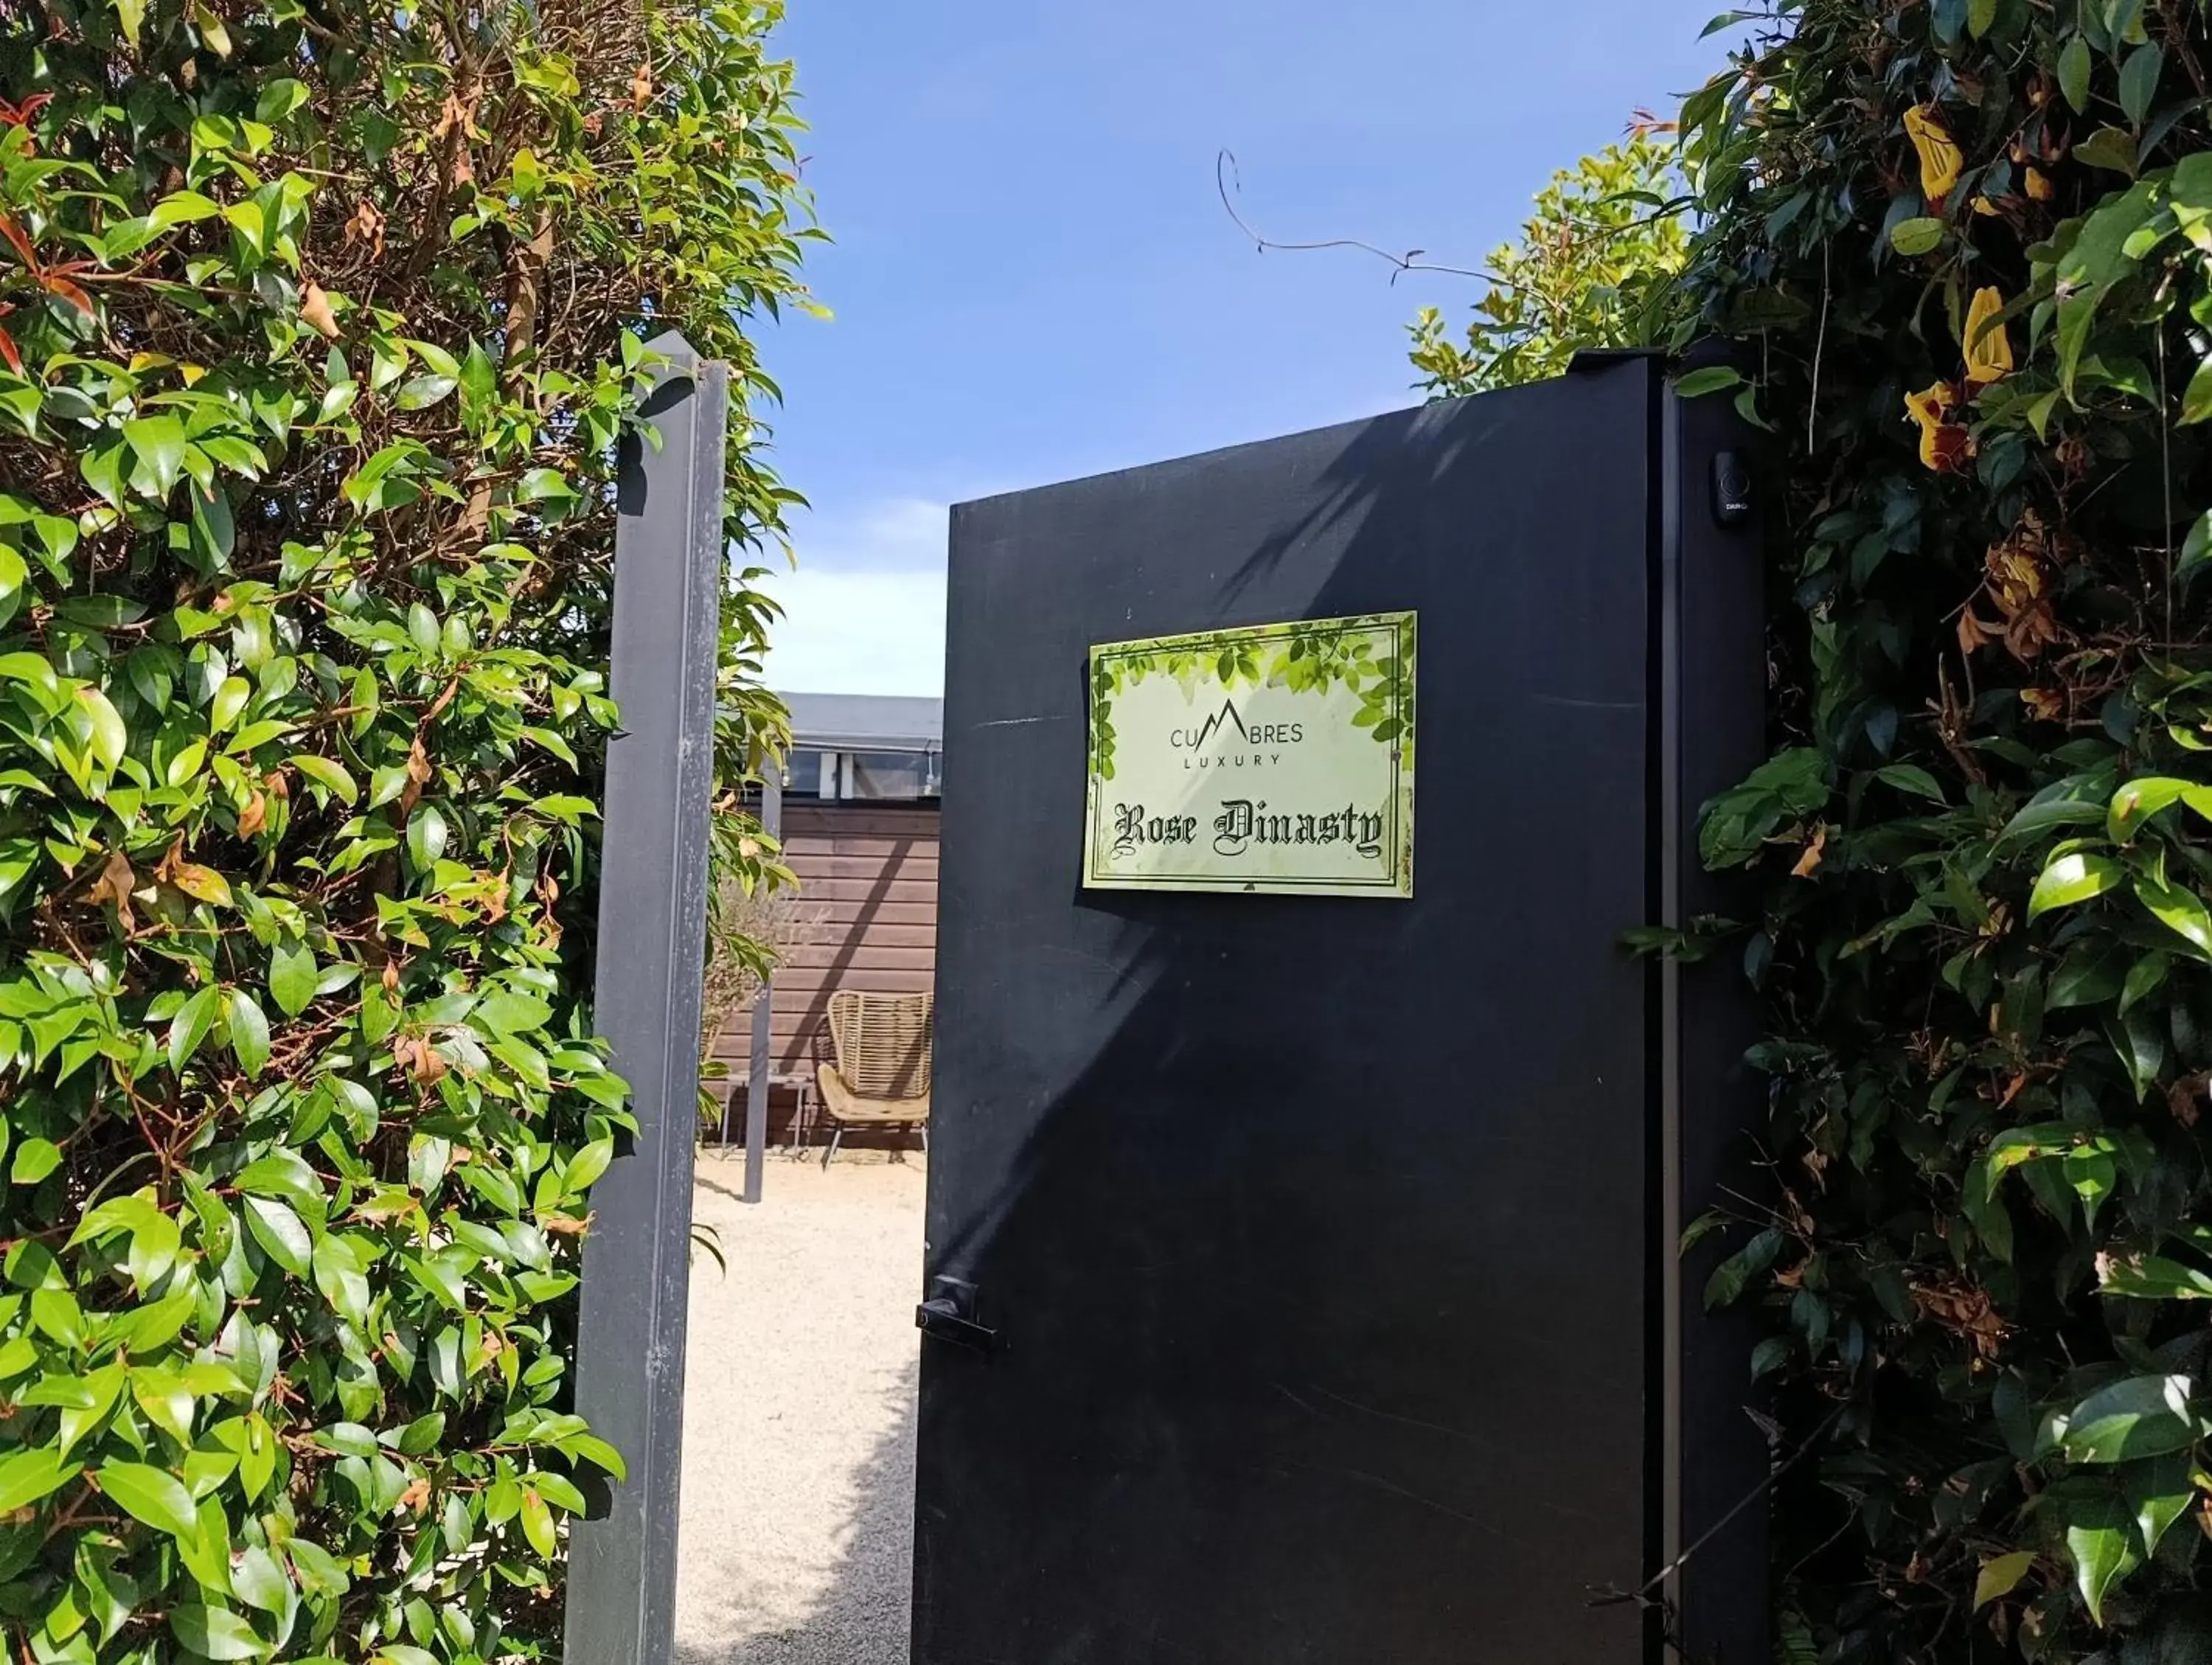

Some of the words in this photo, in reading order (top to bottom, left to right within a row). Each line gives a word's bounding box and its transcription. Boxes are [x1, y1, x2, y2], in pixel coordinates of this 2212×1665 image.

[1184, 754, 1280, 769] LUXURY
[1112, 802, 1197, 860] Rose
[1213, 799, 1382, 858] Dinasty
